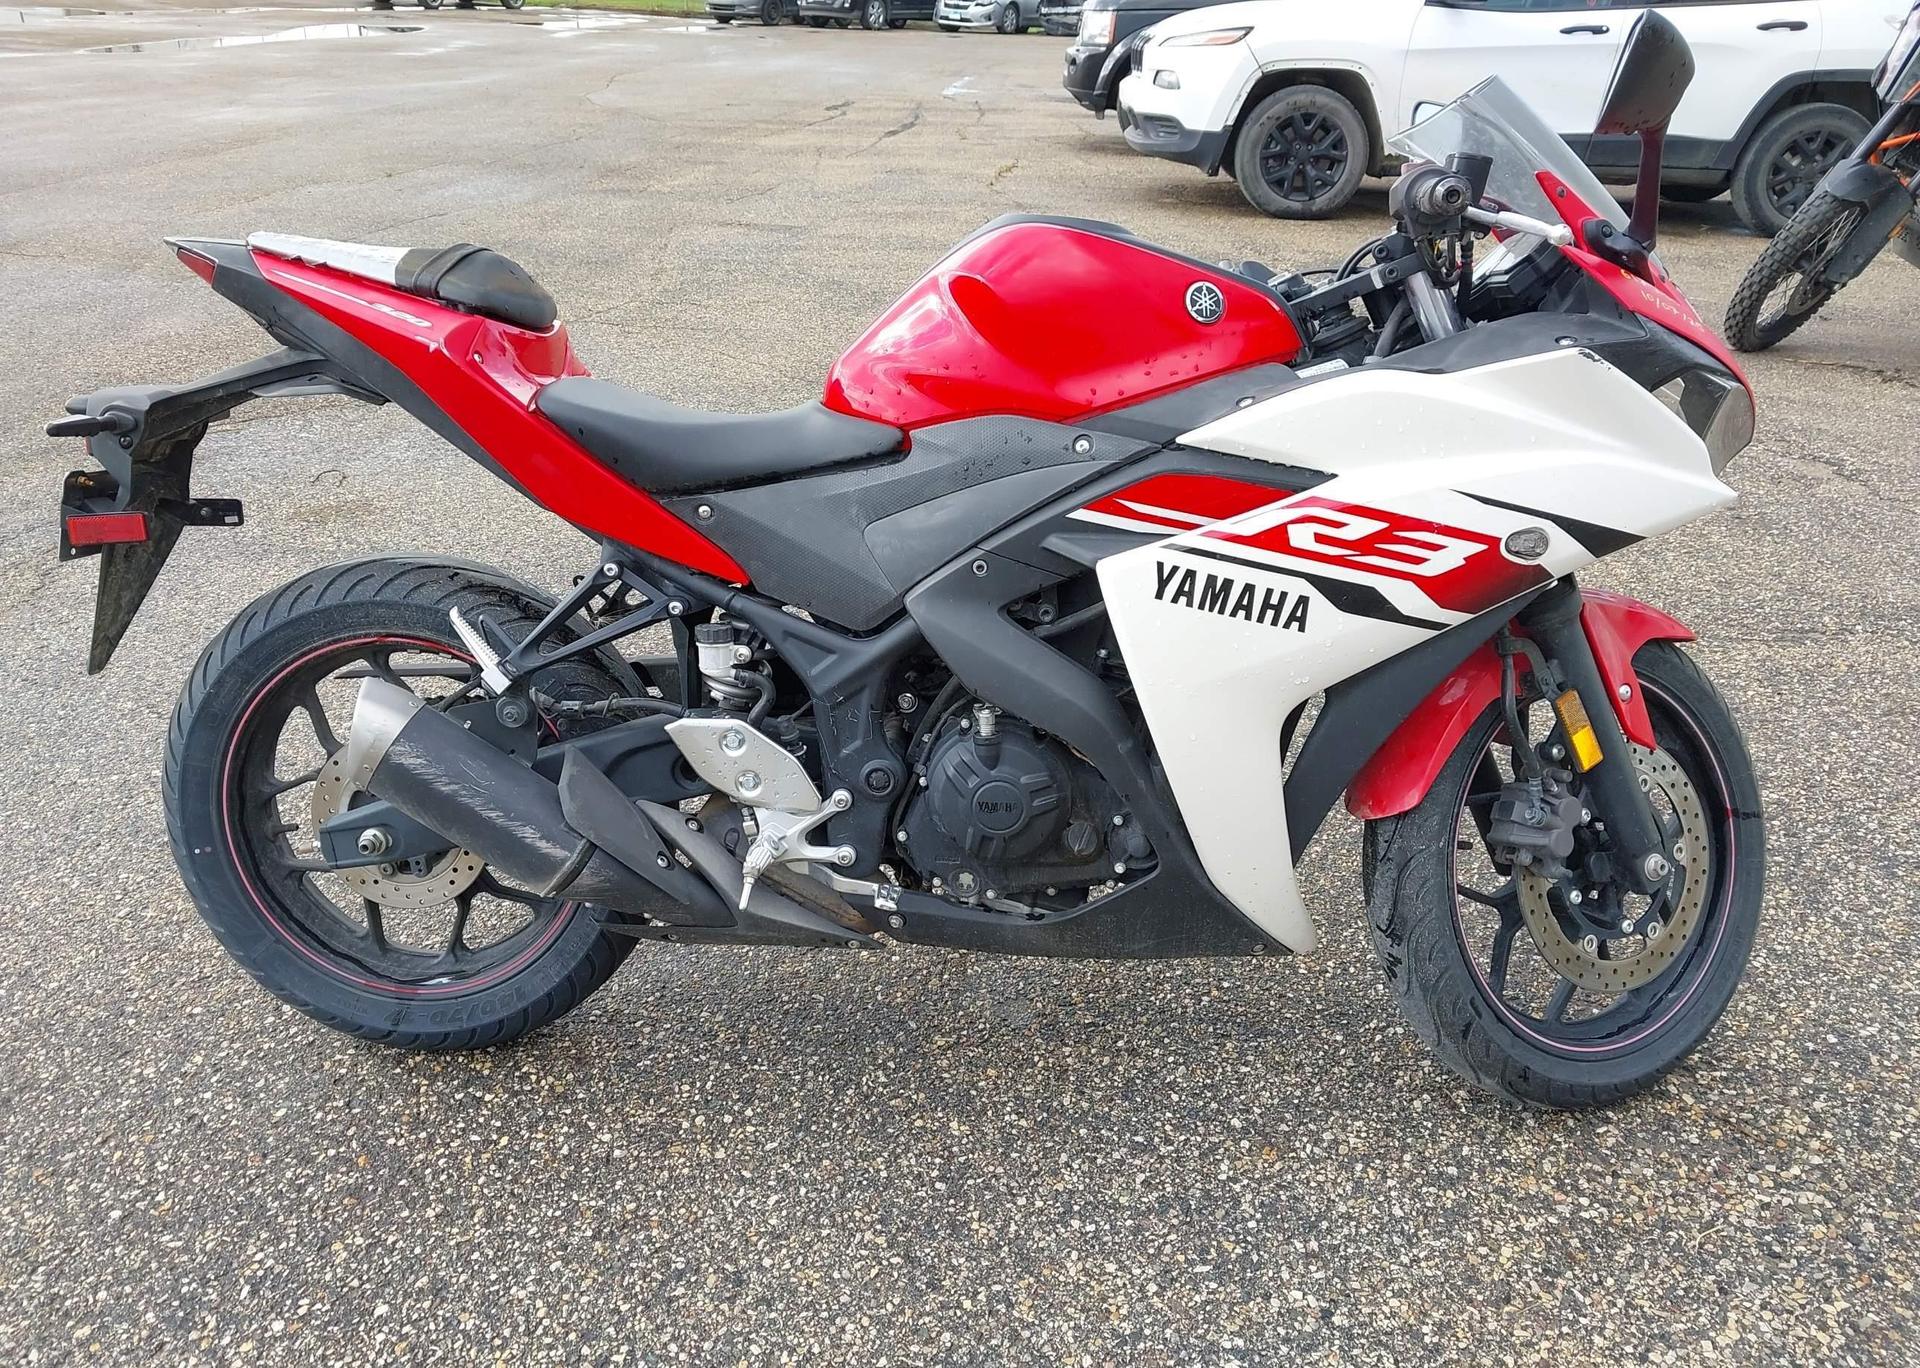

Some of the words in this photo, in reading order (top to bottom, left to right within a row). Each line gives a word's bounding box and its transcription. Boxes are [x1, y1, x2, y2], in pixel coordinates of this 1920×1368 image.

[1228, 506, 1489, 577] R3
[1154, 560, 1310, 633] YAMAHA
[977, 801, 1019, 813] YAMAHA
